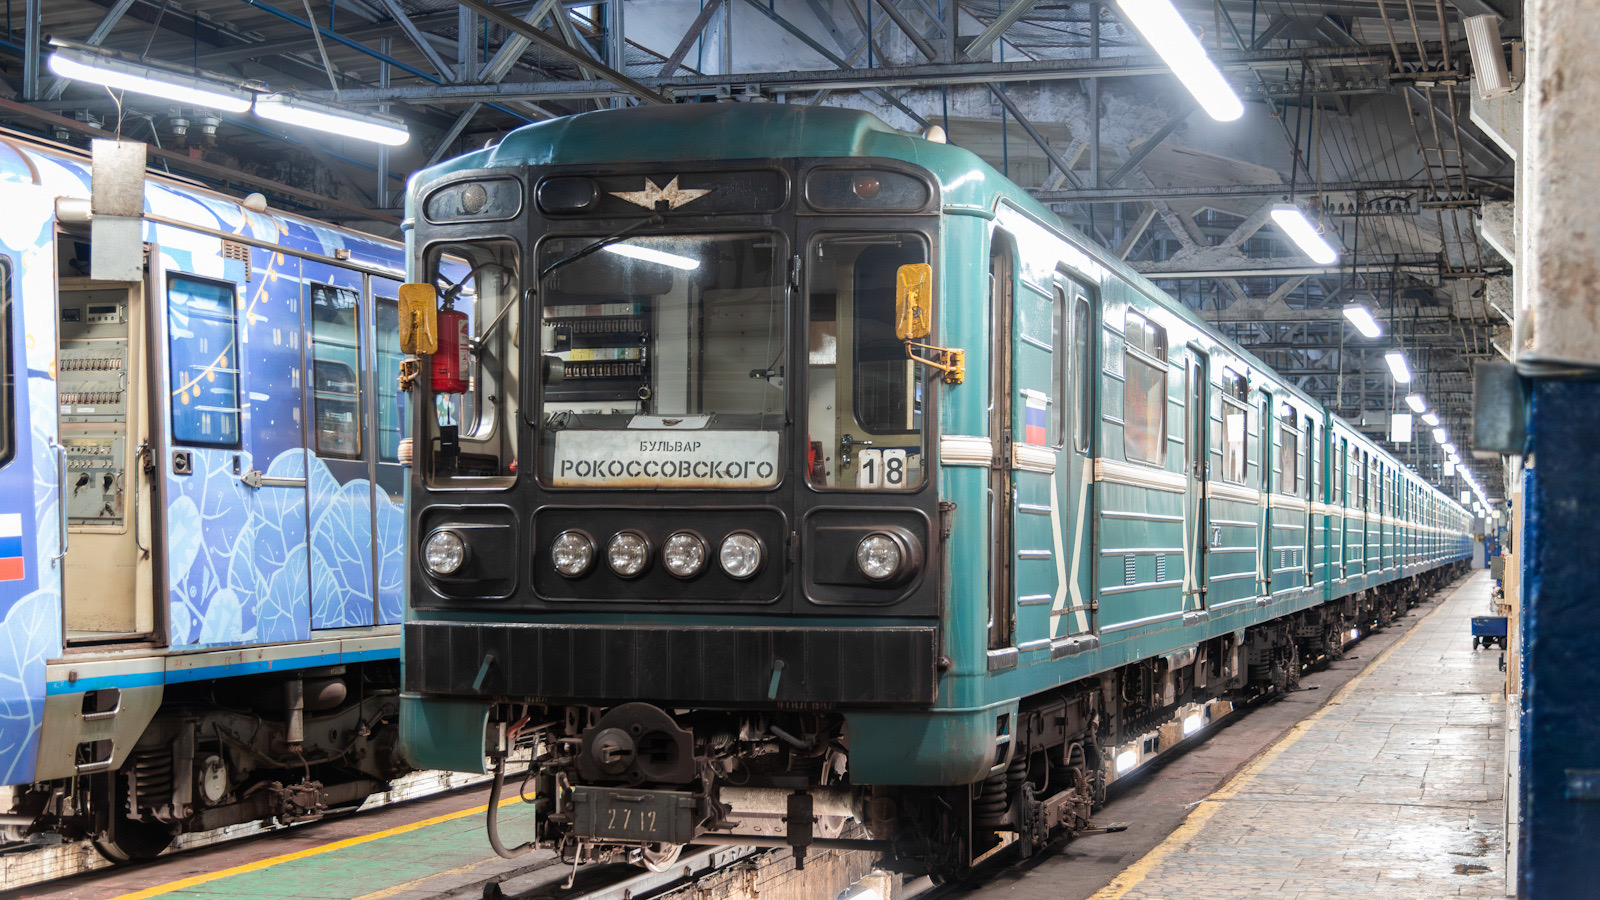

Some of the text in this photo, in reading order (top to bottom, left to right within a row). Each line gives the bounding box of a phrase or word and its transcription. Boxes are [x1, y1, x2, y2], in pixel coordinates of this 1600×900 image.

[639, 440, 701, 453] БУЛЬВАР
[560, 459, 774, 479] РОКОССОВСКОГО
[862, 457, 903, 485] 18
[607, 808, 657, 833] 2712
